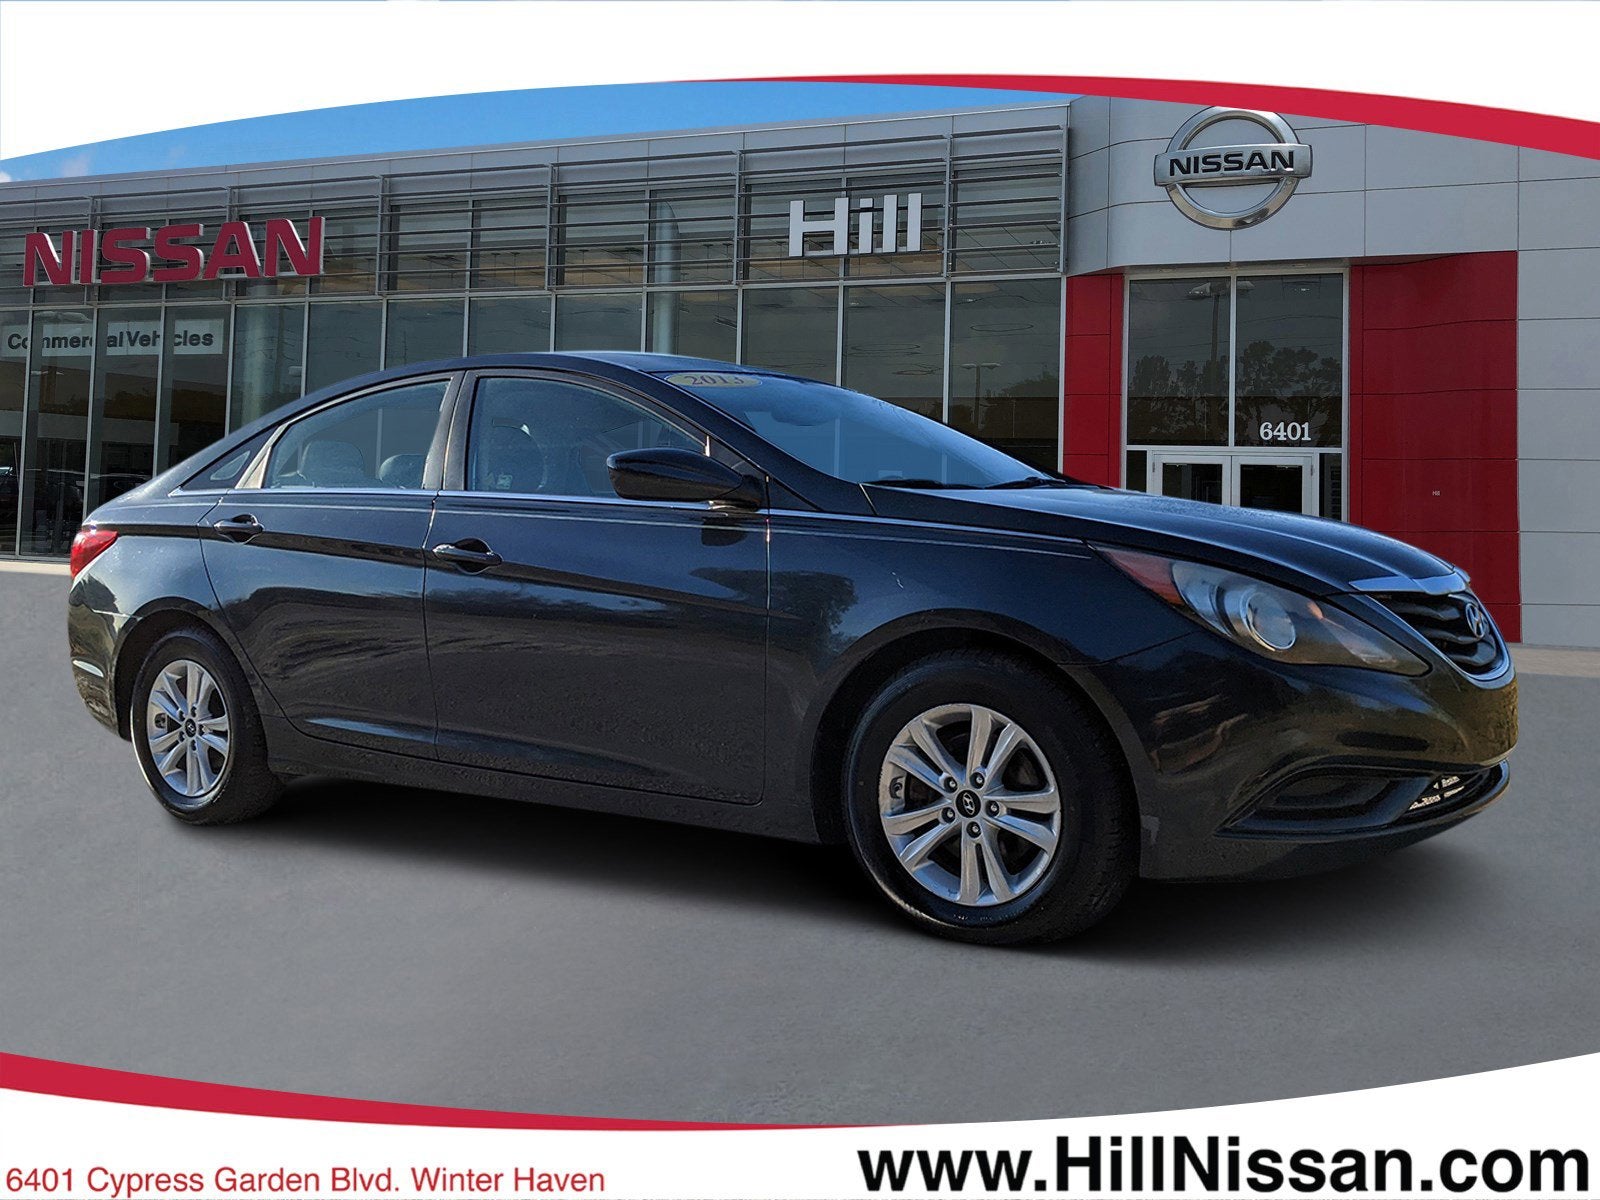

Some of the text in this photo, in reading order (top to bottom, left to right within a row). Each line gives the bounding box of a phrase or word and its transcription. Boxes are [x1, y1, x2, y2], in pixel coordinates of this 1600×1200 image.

[1169, 150, 1295, 177] NISSAN
[788, 192, 922, 258] Hill
[23, 216, 325, 287] NISSAN
[126, 329, 214, 347] Vehcles
[1259, 421, 1312, 442] 6401
